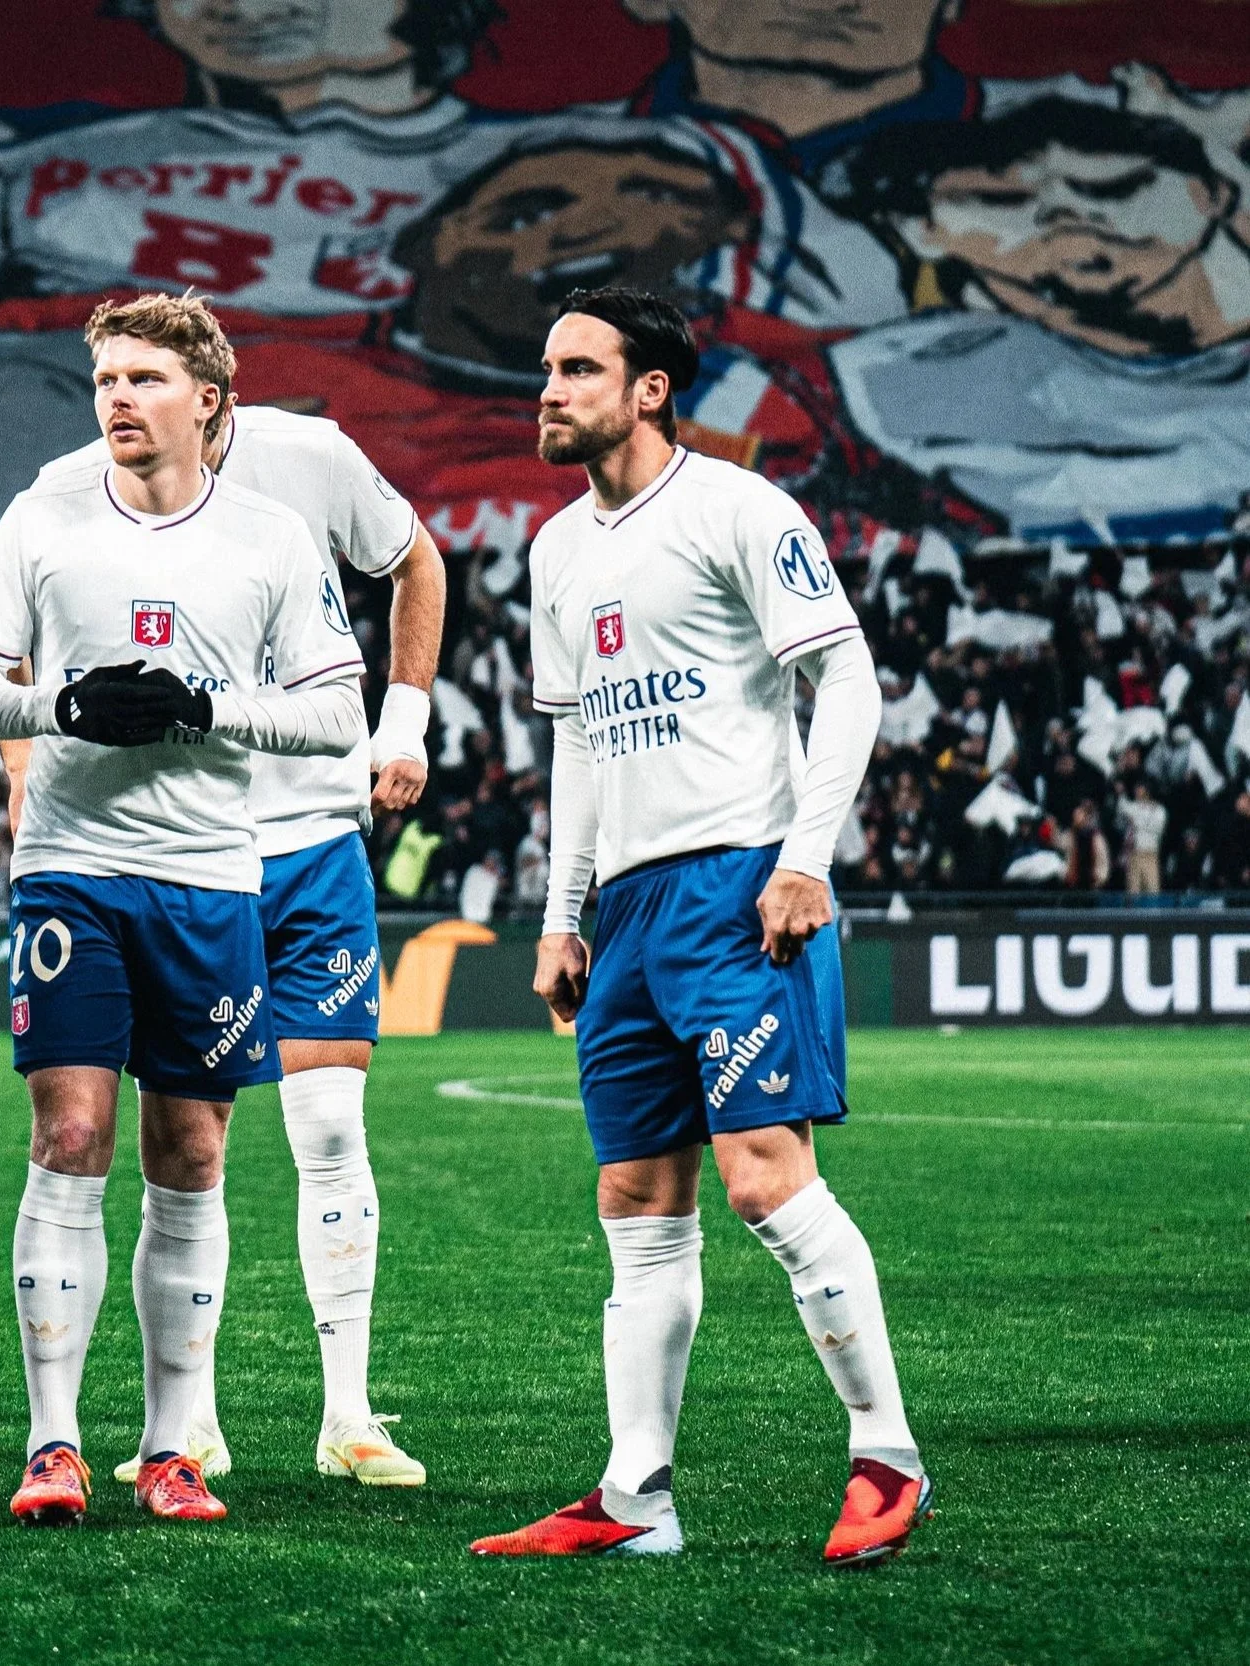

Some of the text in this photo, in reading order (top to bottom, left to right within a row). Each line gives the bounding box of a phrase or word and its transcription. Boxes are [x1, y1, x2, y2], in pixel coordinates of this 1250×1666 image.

[582, 668, 706, 728] mirates
[609, 713, 681, 758] BETTER
[11, 917, 72, 987] 10
[317, 946, 377, 1016] trainline
[201, 985, 263, 1068] trainline
[708, 1013, 779, 1109] trainline
